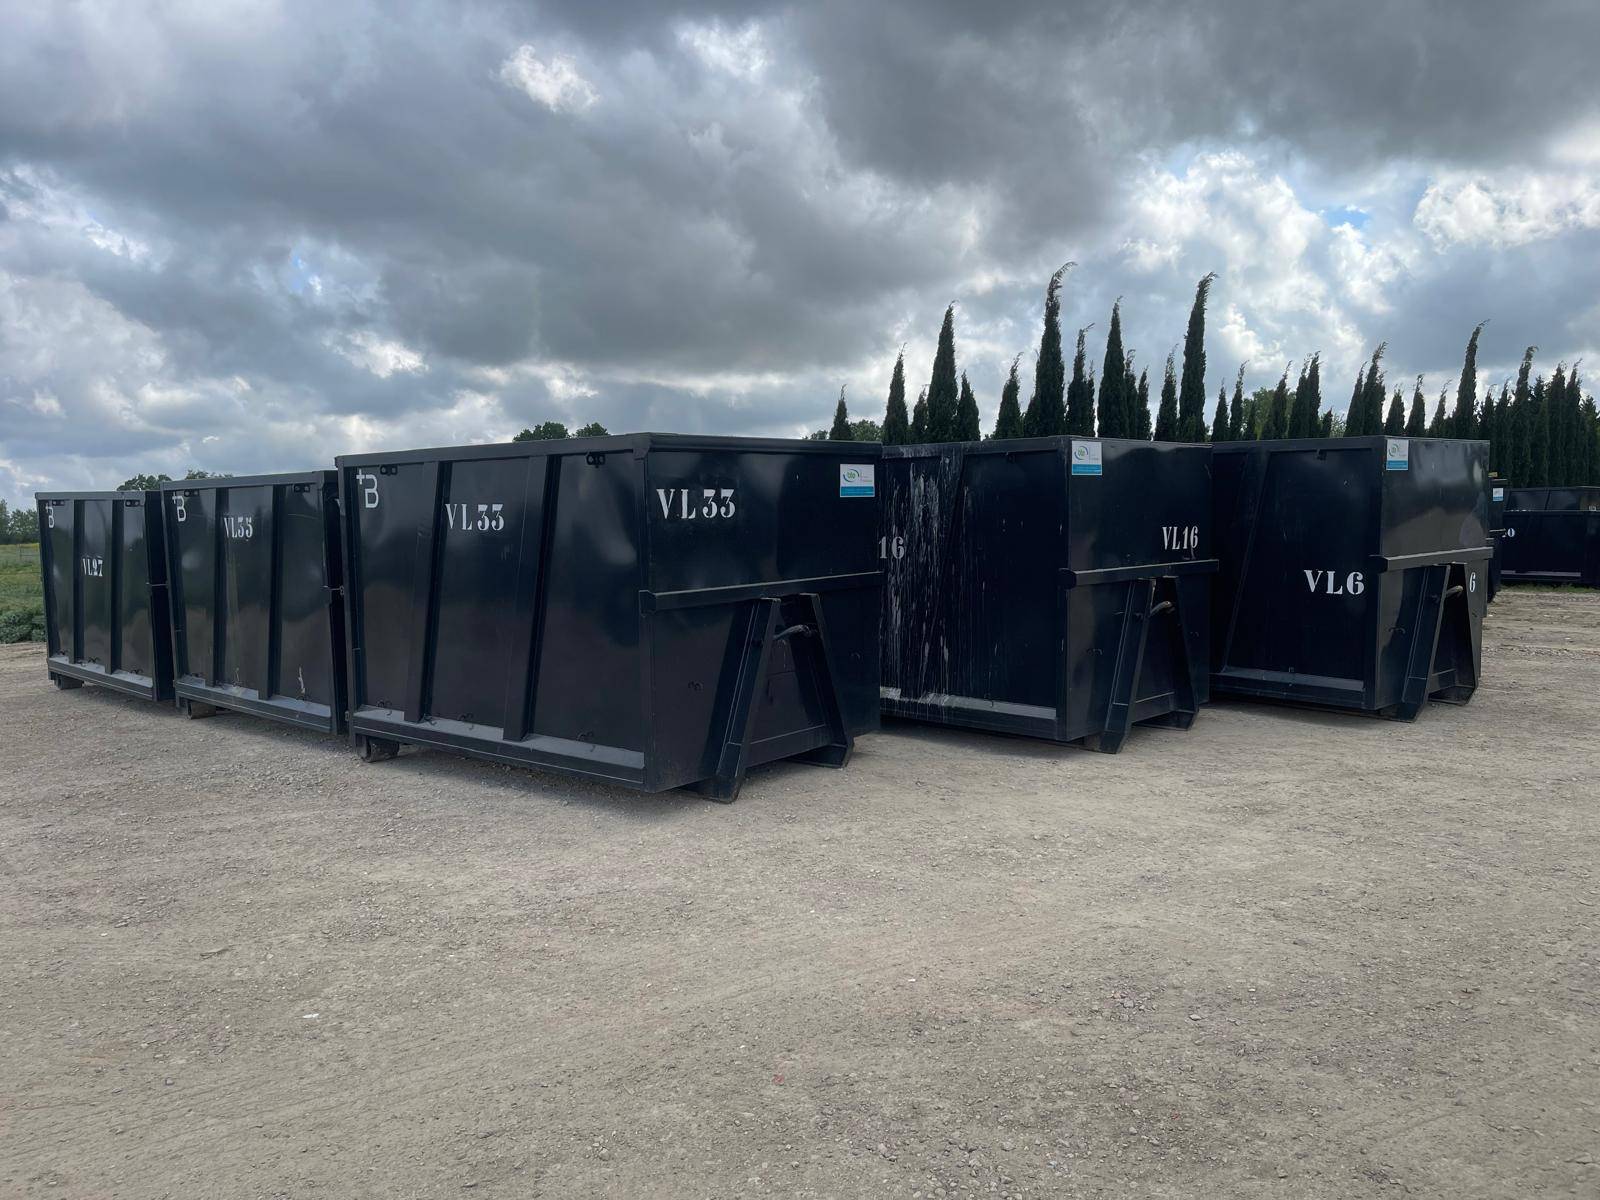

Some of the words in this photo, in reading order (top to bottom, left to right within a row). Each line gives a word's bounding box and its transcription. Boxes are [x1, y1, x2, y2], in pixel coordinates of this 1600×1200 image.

[879, 536, 905, 559] 16
[1162, 525, 1199, 550] VL16
[1304, 569, 1364, 595] VL6
[1470, 571, 1476, 592] 6
